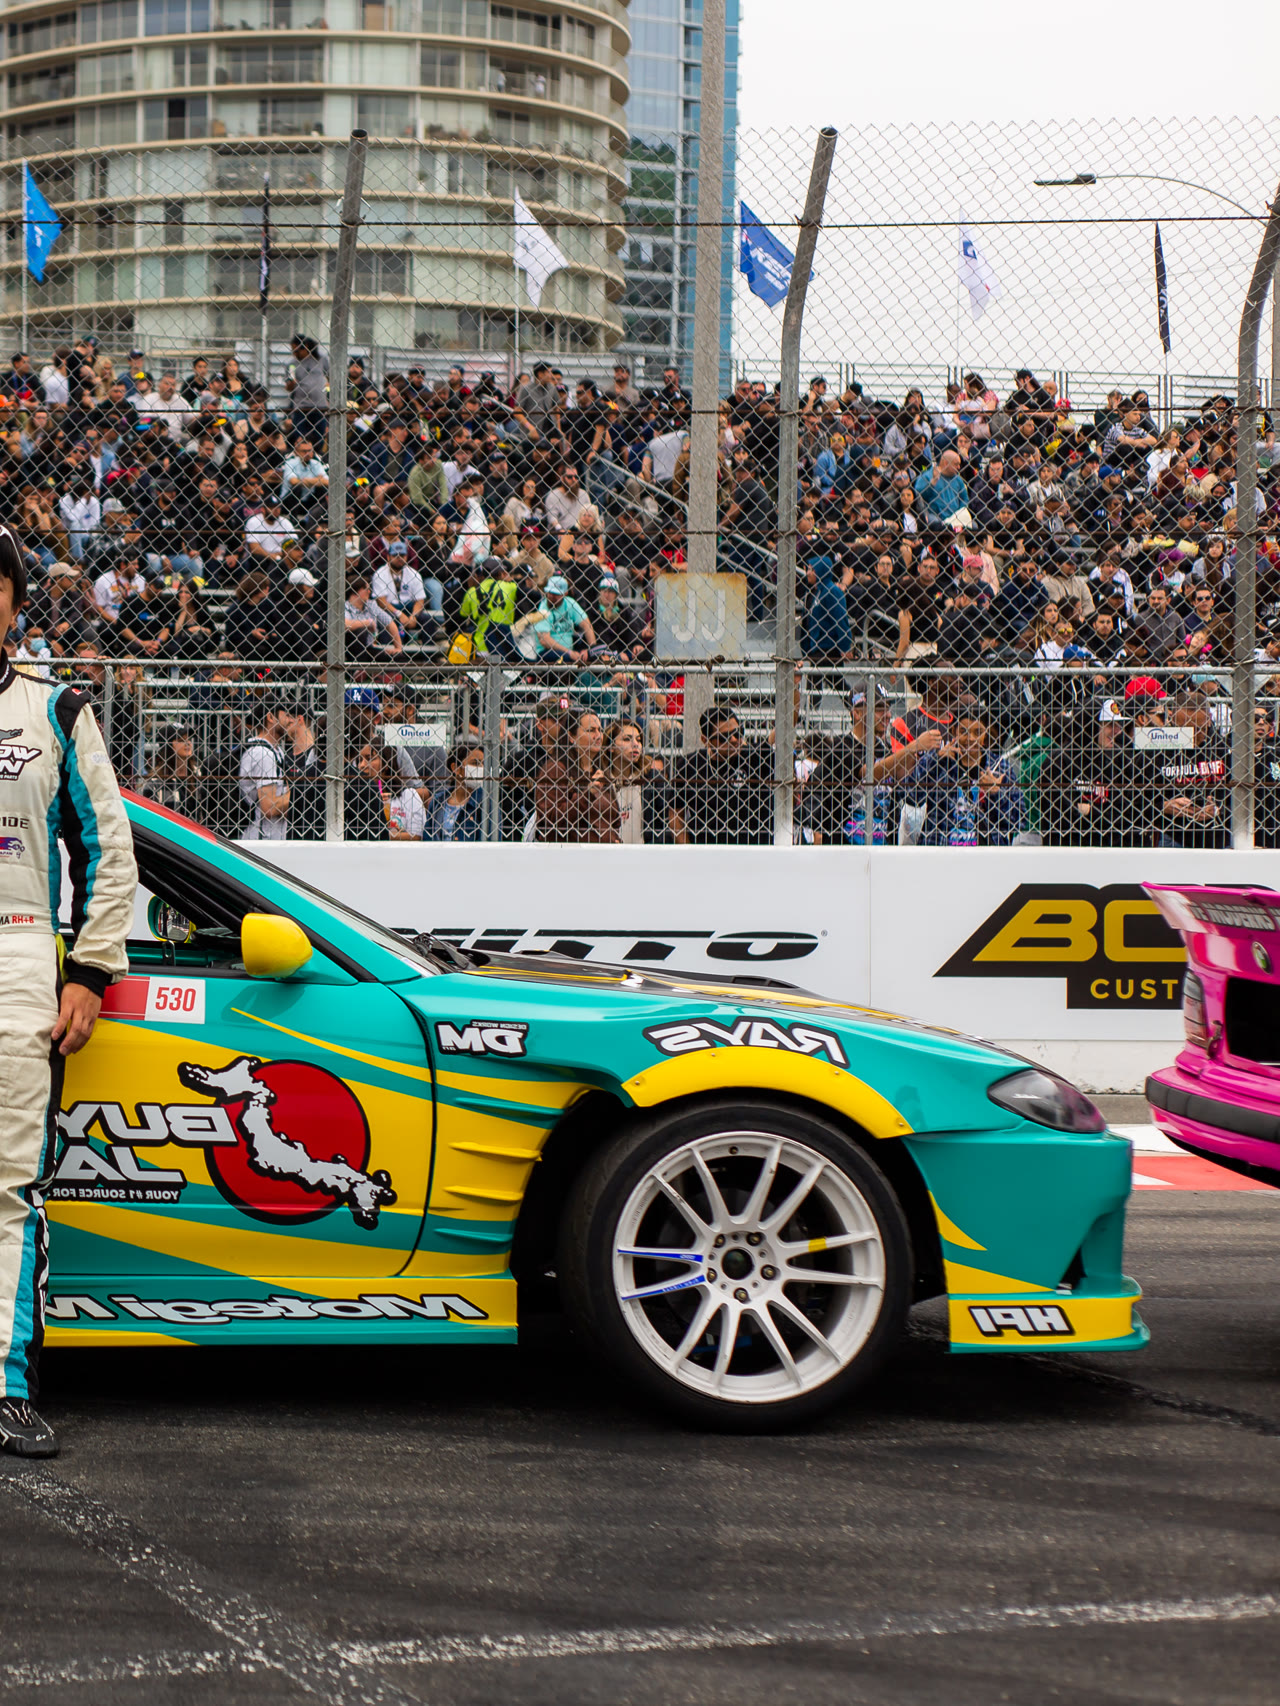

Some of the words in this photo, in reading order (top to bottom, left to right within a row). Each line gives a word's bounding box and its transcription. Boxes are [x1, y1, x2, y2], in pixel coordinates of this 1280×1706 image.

[671, 589, 726, 642] JJ
[401, 728, 430, 736] United
[1151, 732, 1179, 740] United
[155, 986, 197, 1012] 530
[1090, 979, 1179, 1000] CUST
